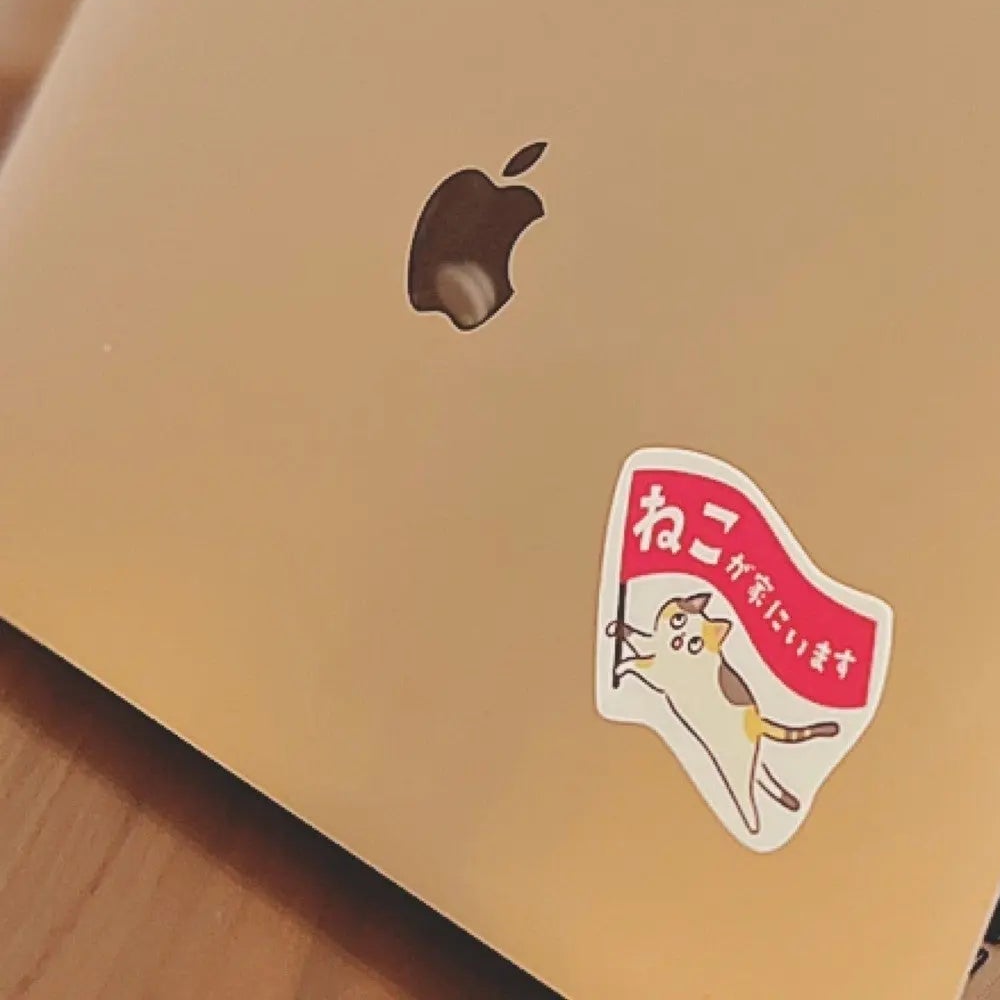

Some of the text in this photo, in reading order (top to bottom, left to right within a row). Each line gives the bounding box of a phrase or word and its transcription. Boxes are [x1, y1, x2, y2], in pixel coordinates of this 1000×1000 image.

[632, 483, 857, 680] ねこが家にいます
